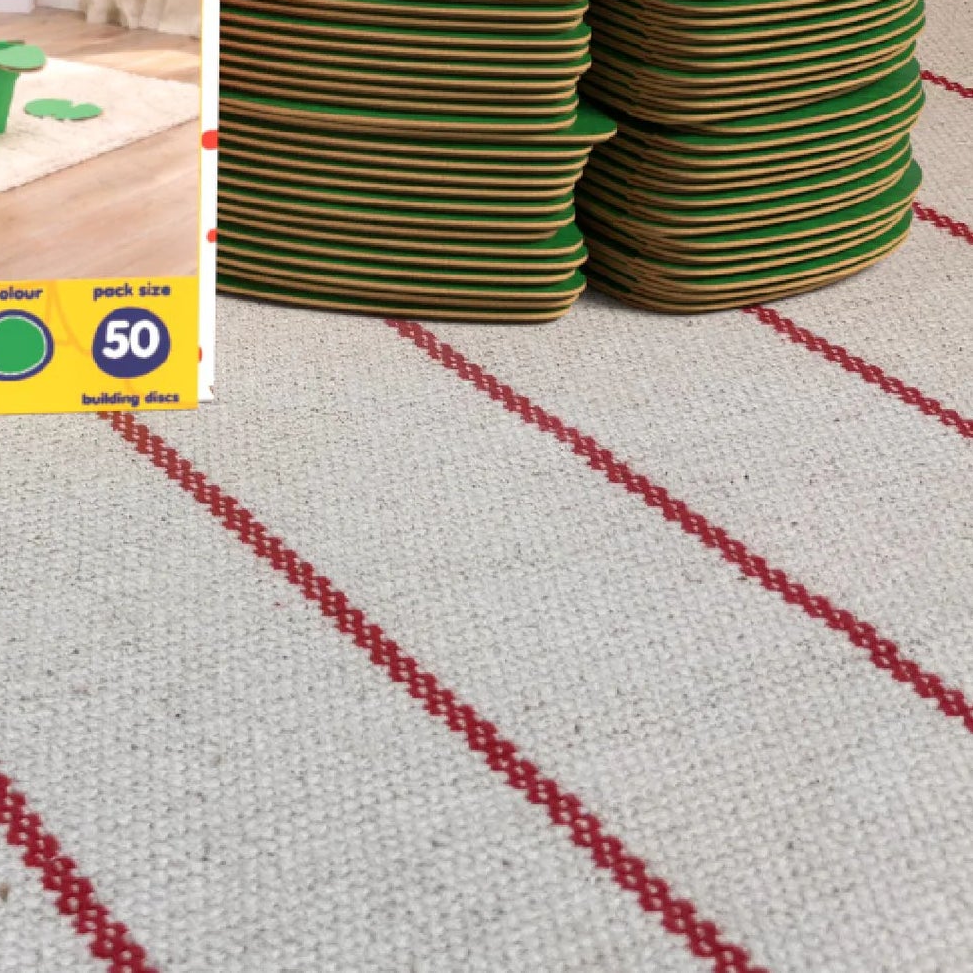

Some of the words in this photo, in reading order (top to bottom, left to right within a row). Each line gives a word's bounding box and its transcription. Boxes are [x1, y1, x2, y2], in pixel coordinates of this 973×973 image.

[93, 283, 133, 300] pack
[139, 284, 171, 296] size
[102, 320, 160, 360] 50
[82, 392, 140, 407] building
[145, 391, 180, 404] discs
